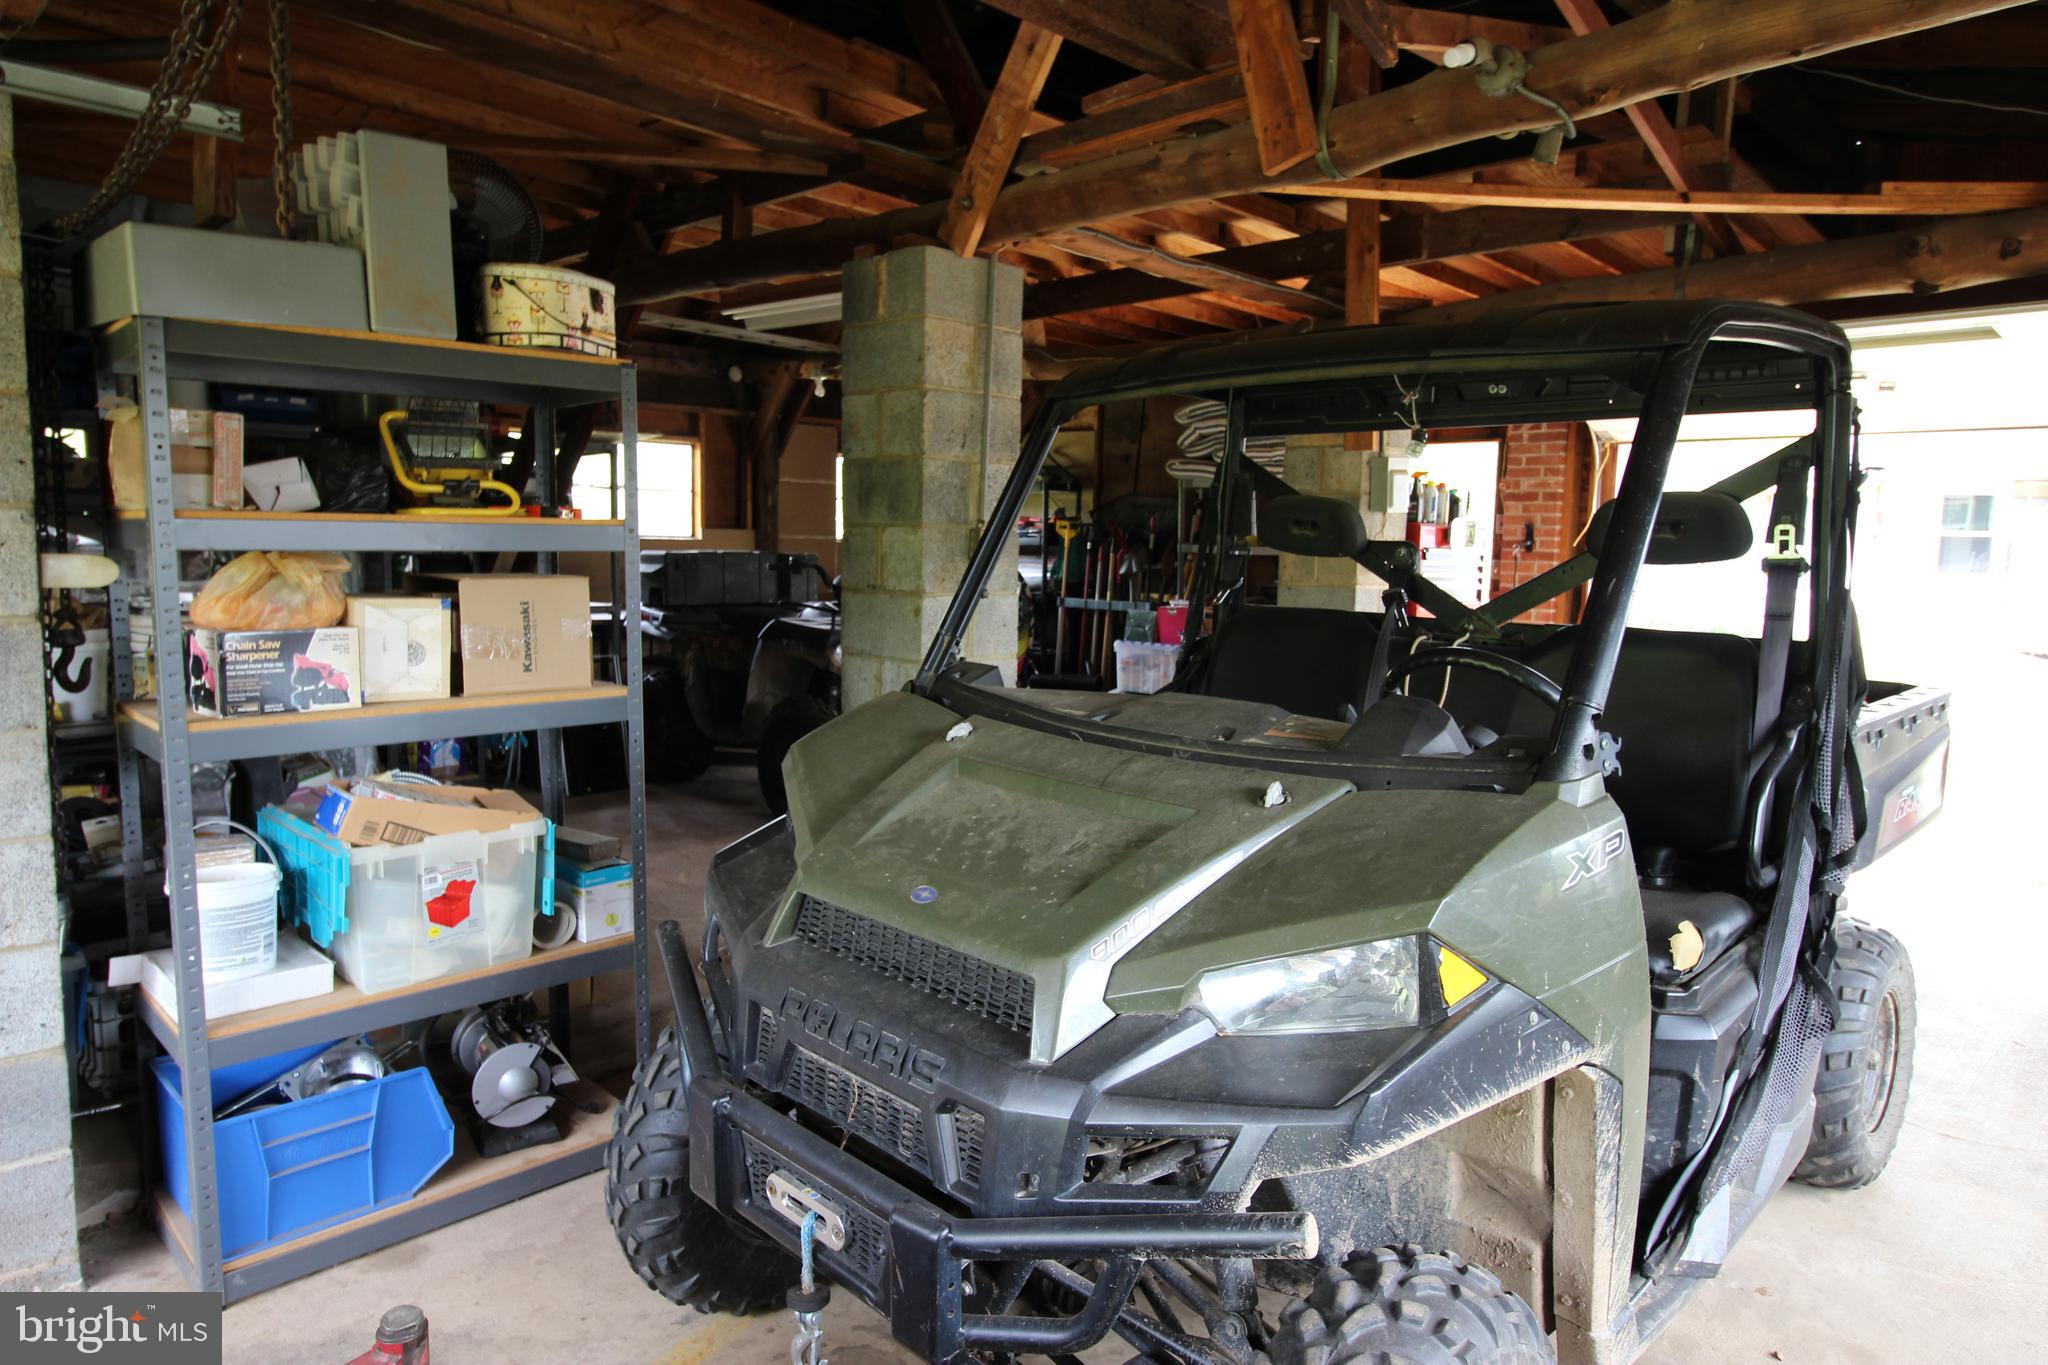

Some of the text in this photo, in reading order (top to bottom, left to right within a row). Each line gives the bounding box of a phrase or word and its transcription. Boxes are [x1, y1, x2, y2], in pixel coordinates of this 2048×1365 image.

[225, 640, 257, 651] Chain
[259, 640, 281, 649] Saw
[225, 651, 280, 662] Sharpener
[519, 601, 533, 673] Kawasaki
[1560, 828, 1626, 892] XP
[779, 985, 946, 1095] POLARIS
